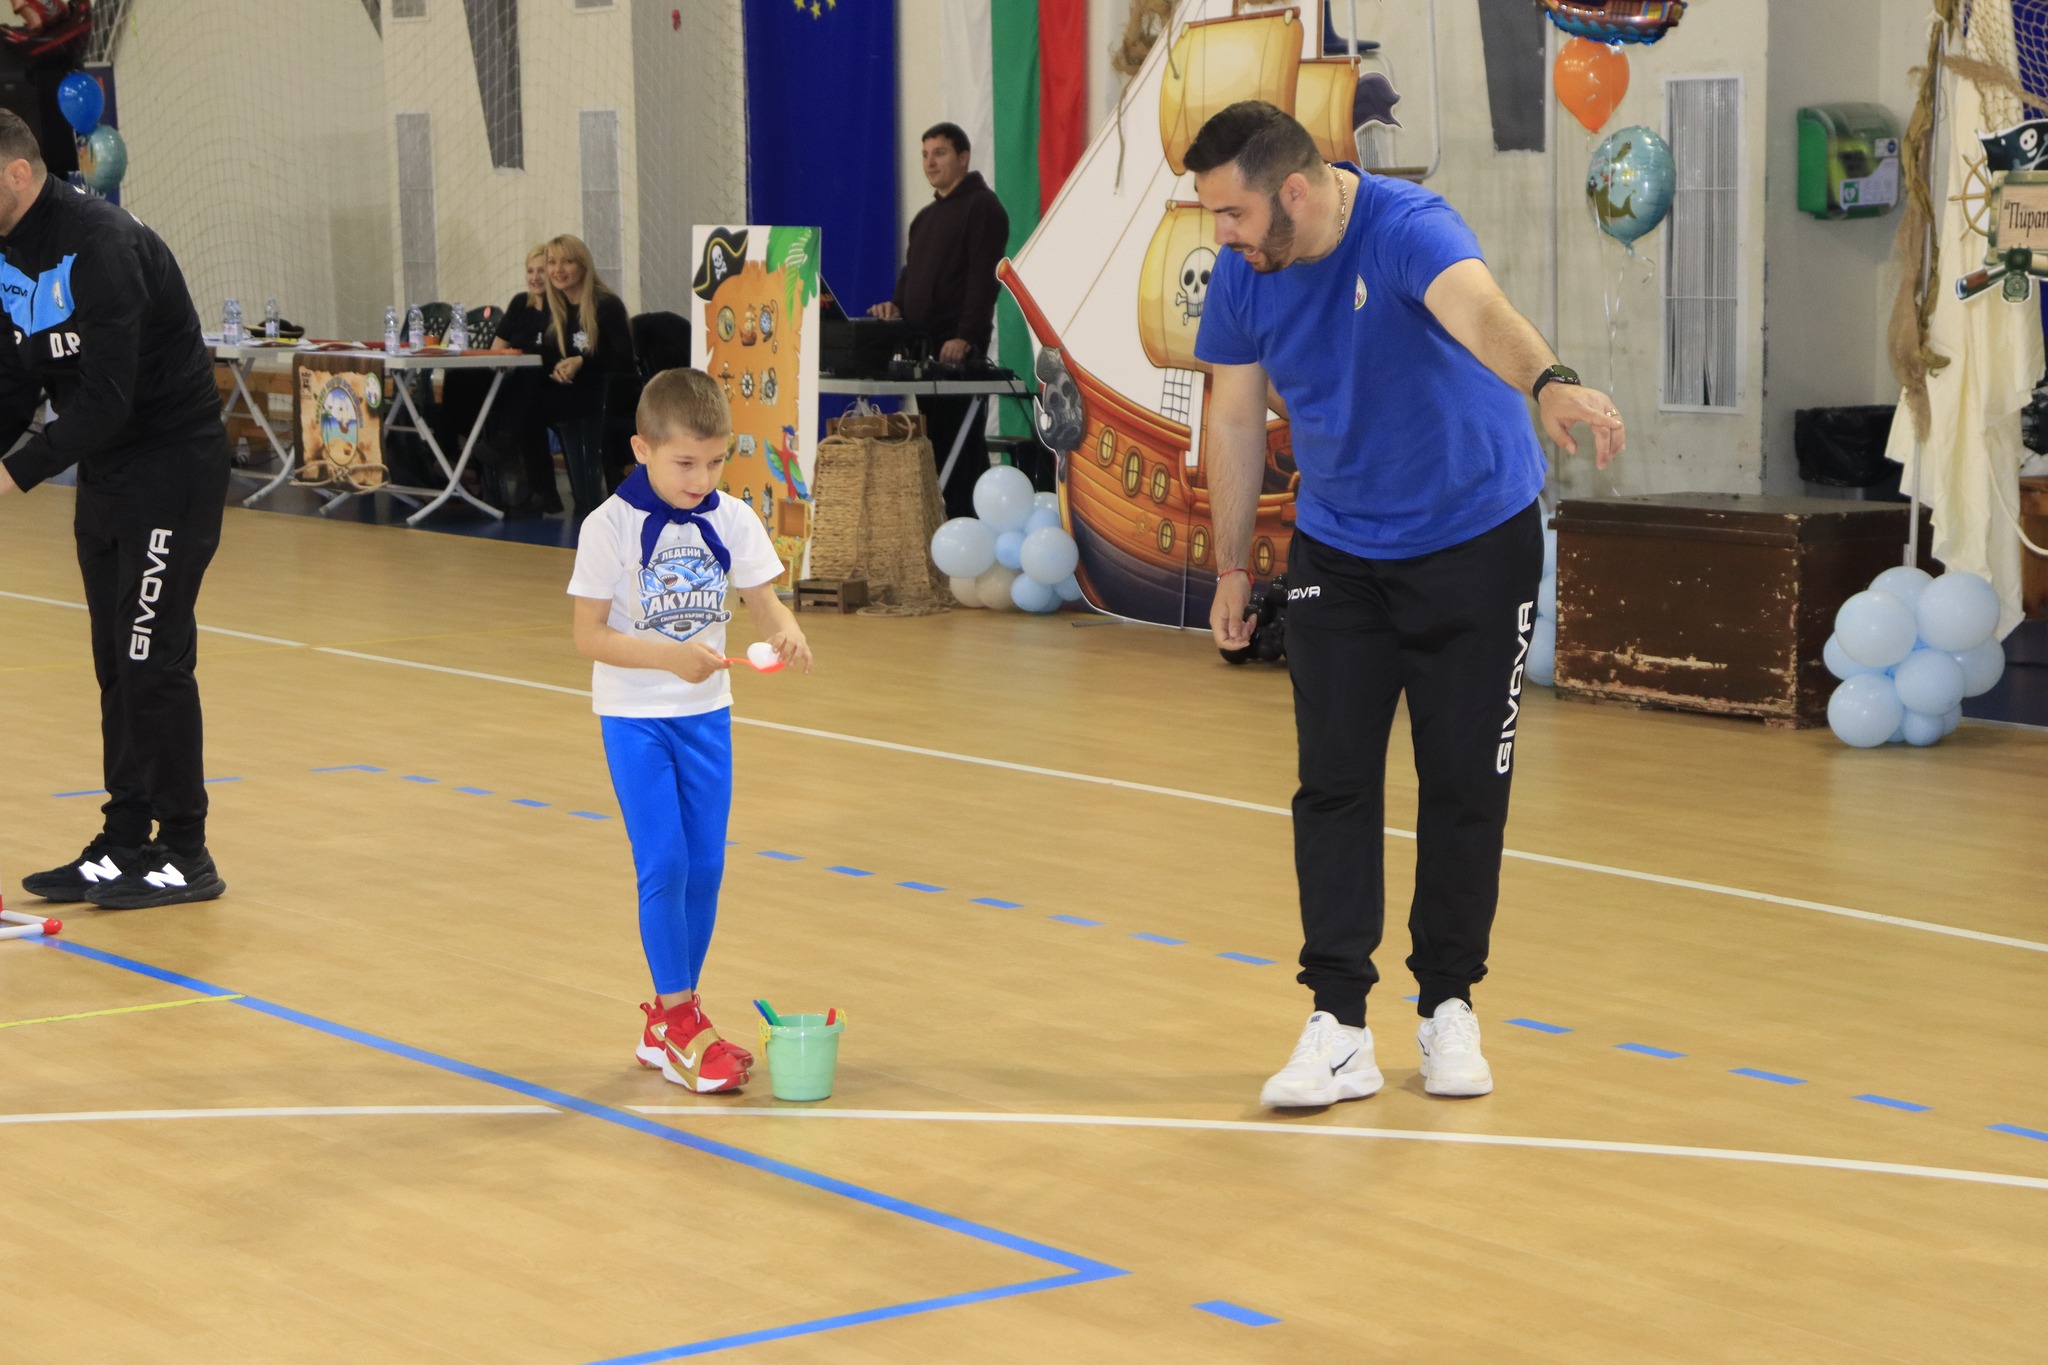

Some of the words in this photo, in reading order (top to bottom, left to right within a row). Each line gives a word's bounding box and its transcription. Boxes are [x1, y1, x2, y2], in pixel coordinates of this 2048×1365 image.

[661, 547, 701, 561] ЛЕДЕНИ
[129, 528, 173, 661] GIVOVA
[646, 591, 718, 617] АКУЛИ
[1496, 600, 1534, 774] GIVOVA
